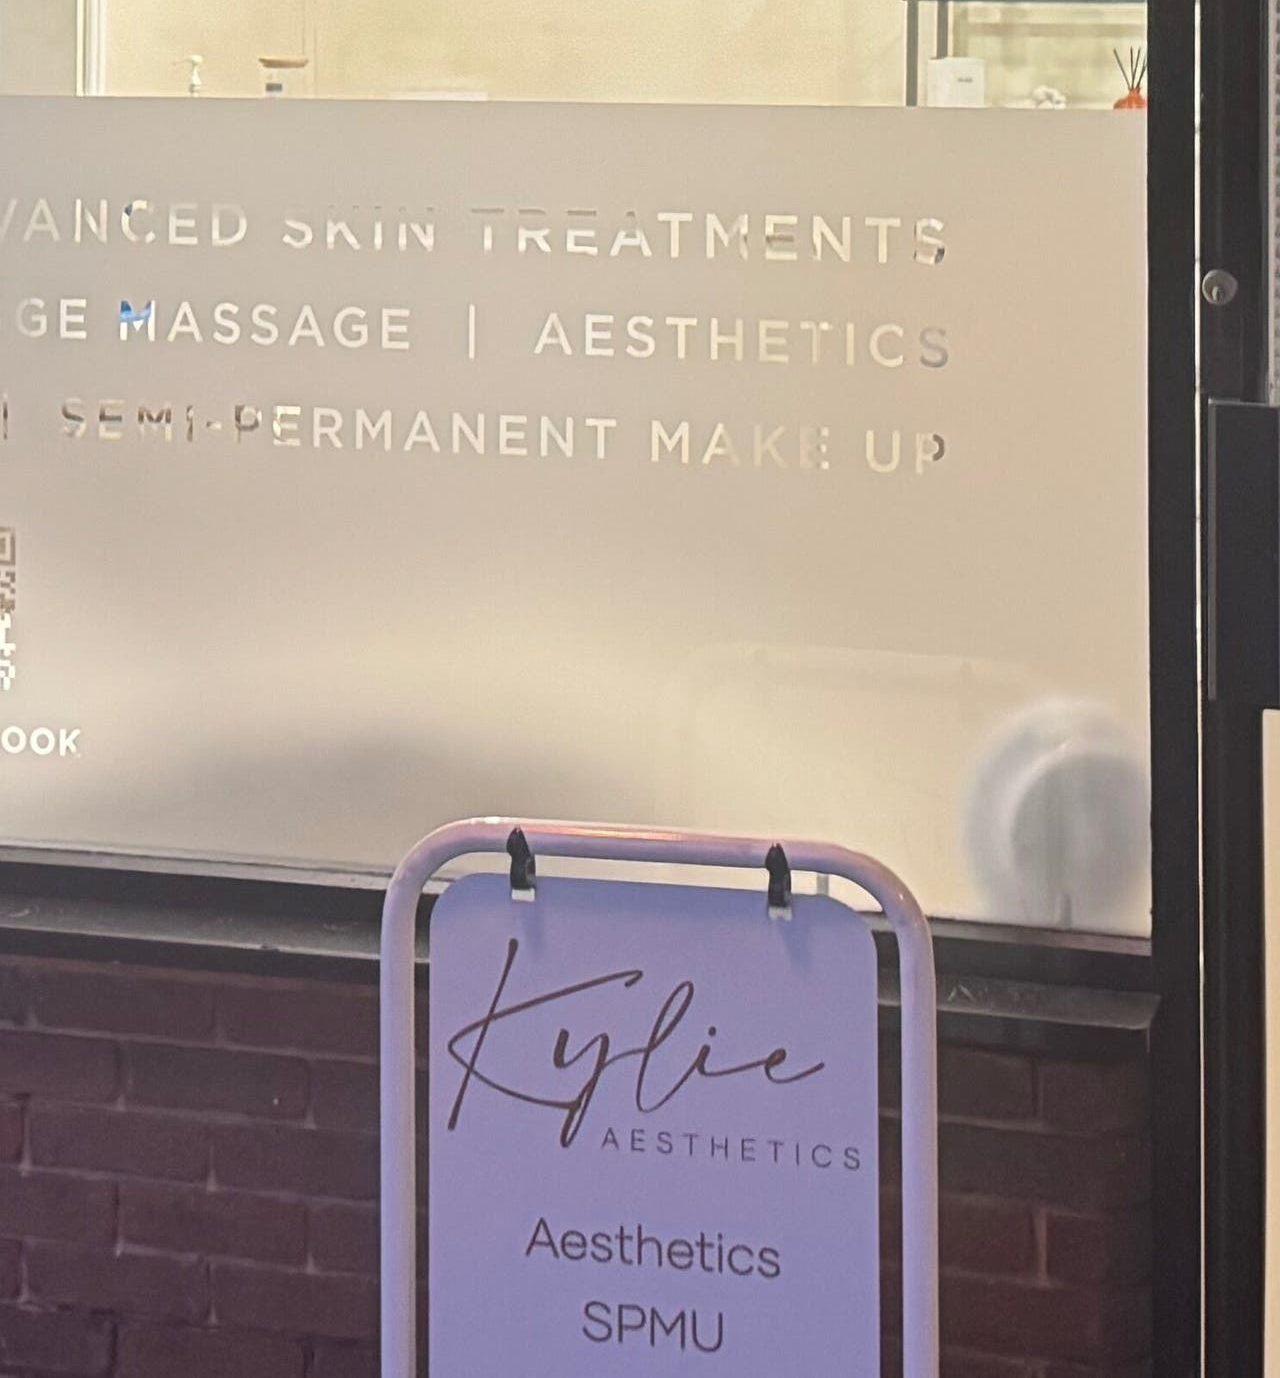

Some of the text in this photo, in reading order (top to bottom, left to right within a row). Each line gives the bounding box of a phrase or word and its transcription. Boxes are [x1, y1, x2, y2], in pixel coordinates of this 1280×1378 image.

[280, 204, 435, 253] SKIN
[470, 206, 946, 265] TREATMENTS
[119, 300, 411, 351] MASSAGE
[533, 311, 950, 369] AESTHETICS
[60, 397, 618, 460] SEMI-PERMANENT
[649, 419, 830, 470] MAKE
[865, 429, 946, 475] UP
[447, 938, 825, 1148] Kylie
[600, 1126, 862, 1171] AESTHETICS
[524, 1216, 782, 1278] Aesthetics
[581, 1300, 724, 1353] SPMU
